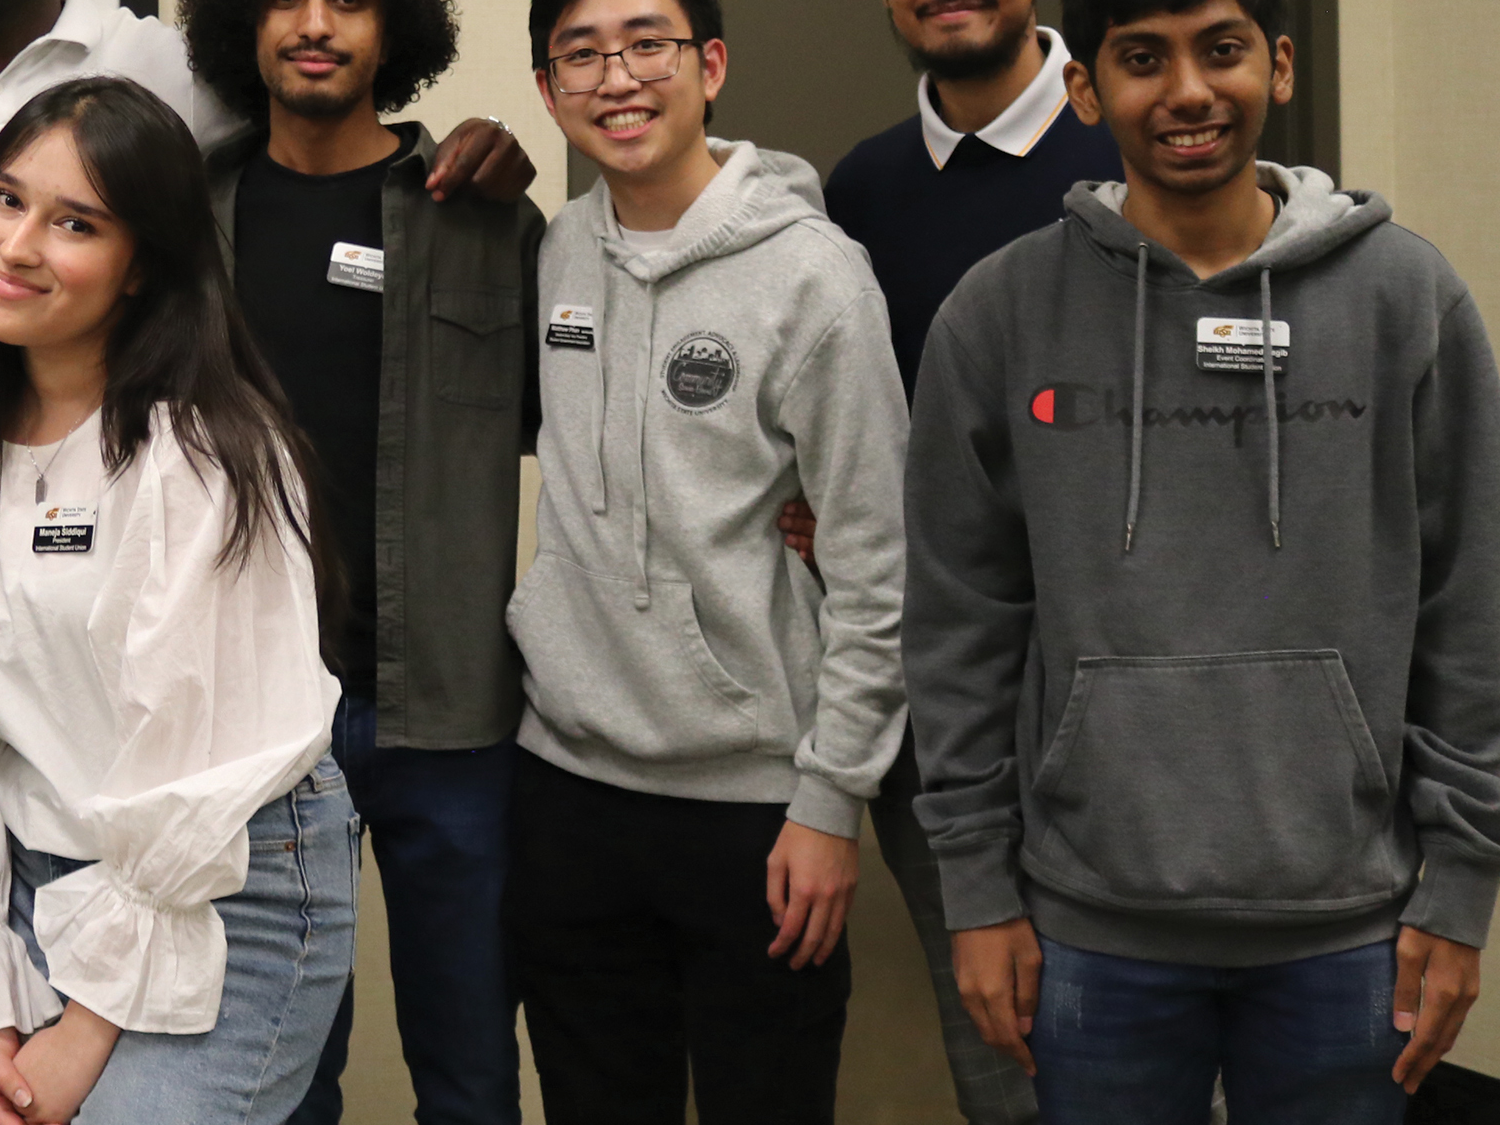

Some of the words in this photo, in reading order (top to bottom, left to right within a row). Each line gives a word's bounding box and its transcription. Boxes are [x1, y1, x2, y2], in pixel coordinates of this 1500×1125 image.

[339, 264, 355, 274] Yoel
[1197, 345, 1225, 354] Sheikh
[1226, 346, 1264, 356] Mohamed
[1270, 348, 1289, 358] agib
[1234, 355, 1265, 363] Coordinat
[1203, 362, 1240, 370] International
[1240, 363, 1264, 371] Student
[1027, 381, 1366, 449] Champion
